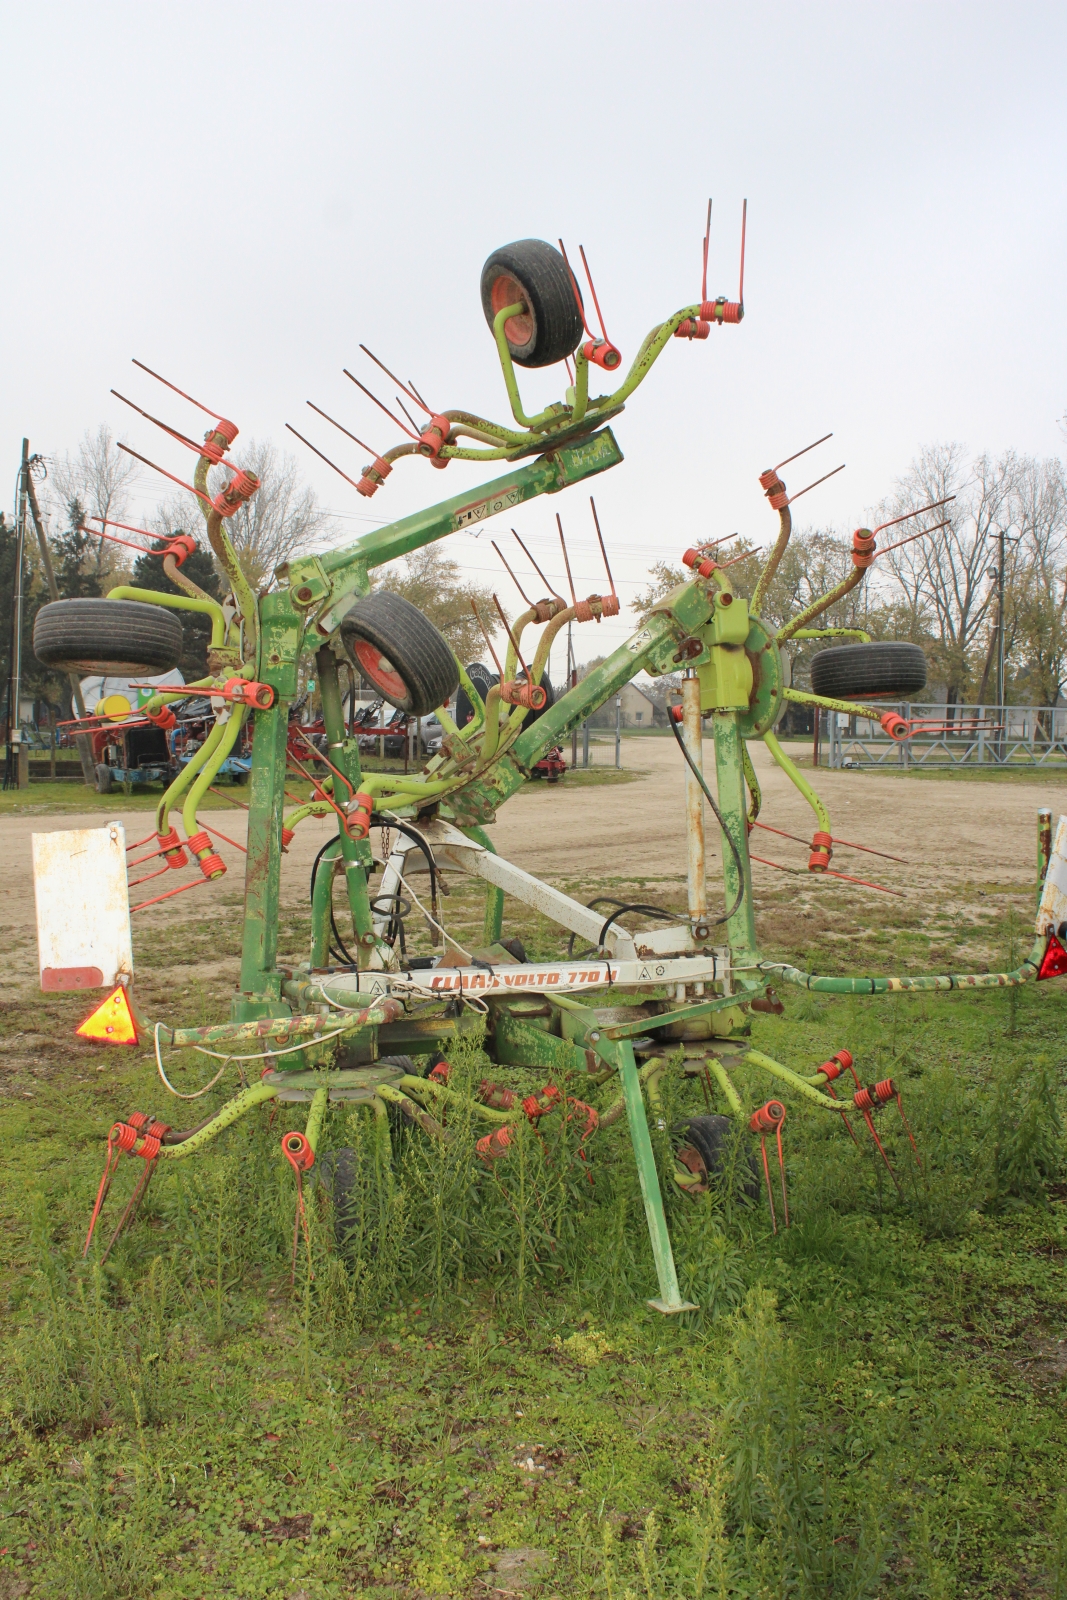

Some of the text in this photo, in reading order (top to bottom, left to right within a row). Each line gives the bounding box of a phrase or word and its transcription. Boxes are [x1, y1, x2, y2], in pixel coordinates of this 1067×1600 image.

[431, 973, 501, 990] CLAAS
[503, 972, 560, 987] VOLTO
[567, 970, 601, 984] 770
